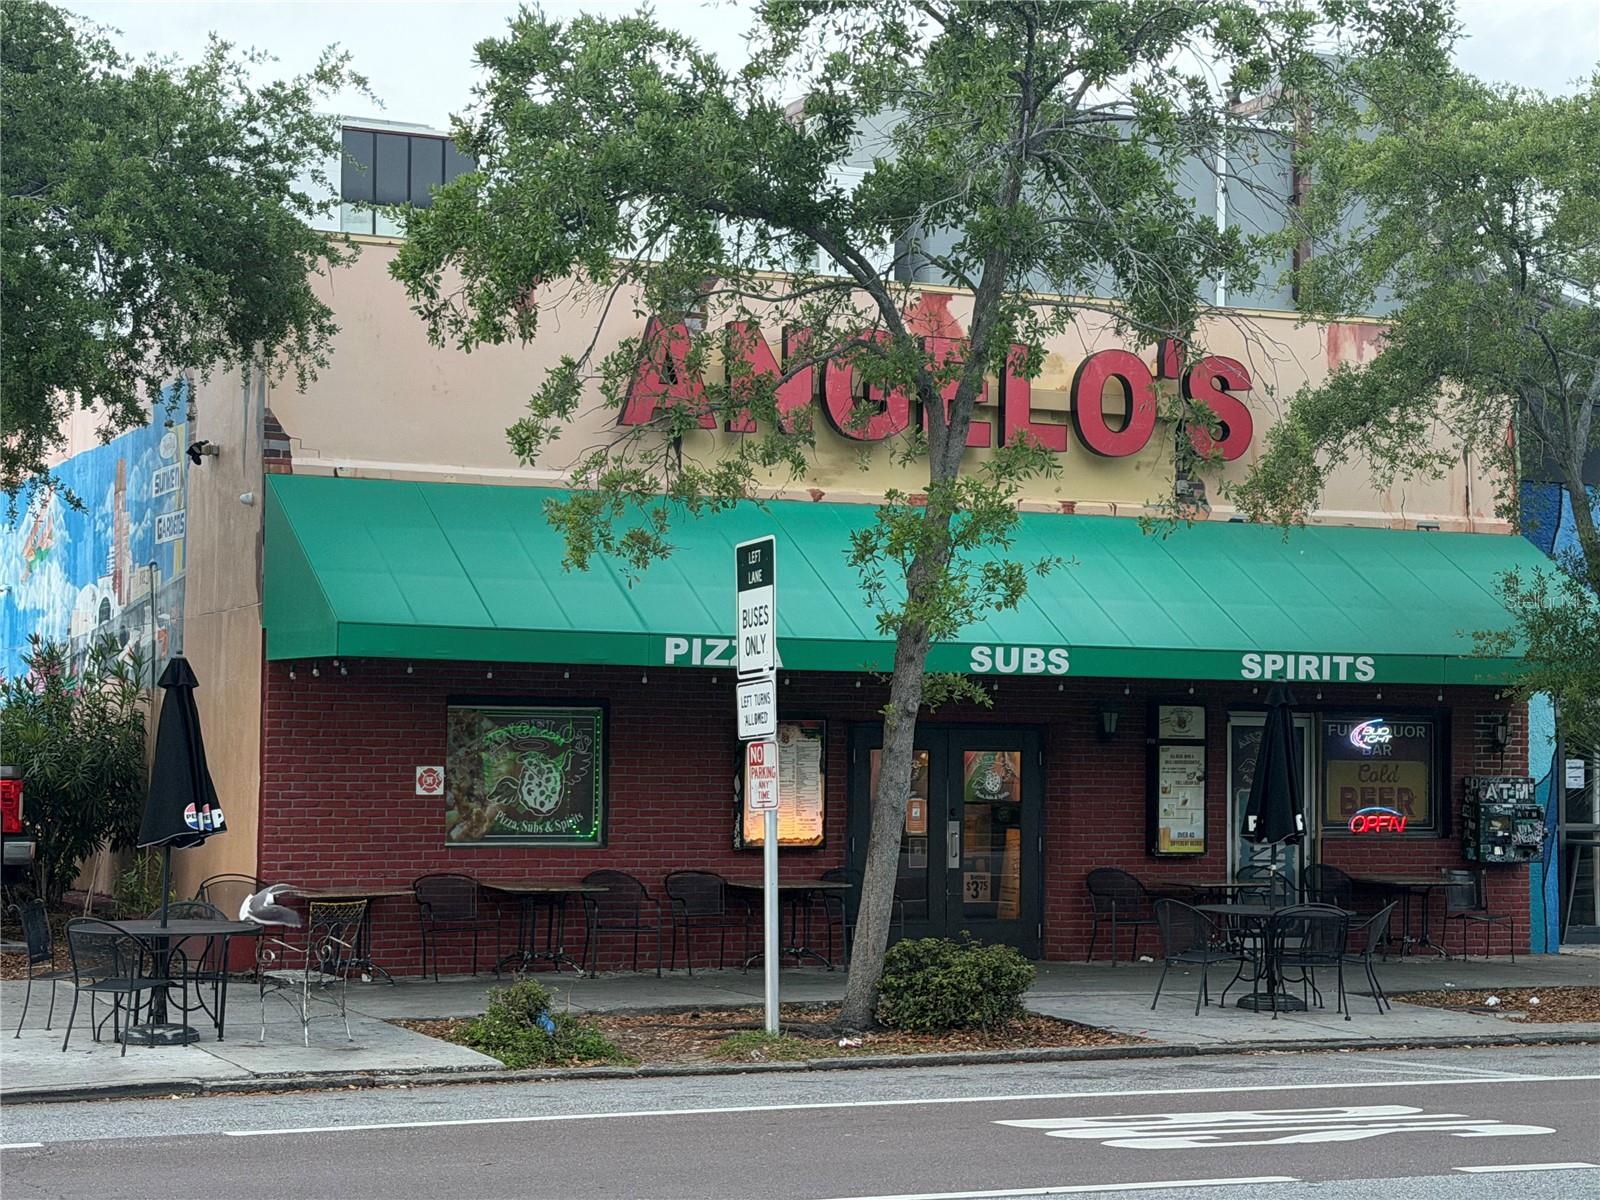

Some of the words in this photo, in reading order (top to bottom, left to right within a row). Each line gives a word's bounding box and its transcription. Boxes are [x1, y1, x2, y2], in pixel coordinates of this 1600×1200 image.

[617, 312, 1254, 461] ANGELO'S
[157, 513, 185, 540] GARDENS
[748, 549, 762, 565] LEFT
[748, 568, 763, 585] LANE
[742, 604, 769, 629] BUSES
[665, 637, 784, 668] PIZ
[744, 632, 766, 658] ONLY
[969, 646, 1070, 675] SUBS
[1241, 653, 1376, 682] SPIRITS
[741, 695, 753, 709] LEFT
[754, 691, 771, 706] TURNS
[744, 711, 769, 727] ALLOWED
[1362, 726, 1389, 736] BUD
[750, 745, 763, 763] NO
[751, 766, 776, 780] PARKING
[1358, 764, 1400, 783] Cold
[759, 780, 770, 789] ANY
[1486, 783, 1529, 800] ATM
[758, 790, 770, 800] TIME
[1340, 786, 1415, 816] BEER
[521, 819, 543, 833] Subs
[545, 820, 554, 833] &
[1351, 815, 1408, 832] OPEN
